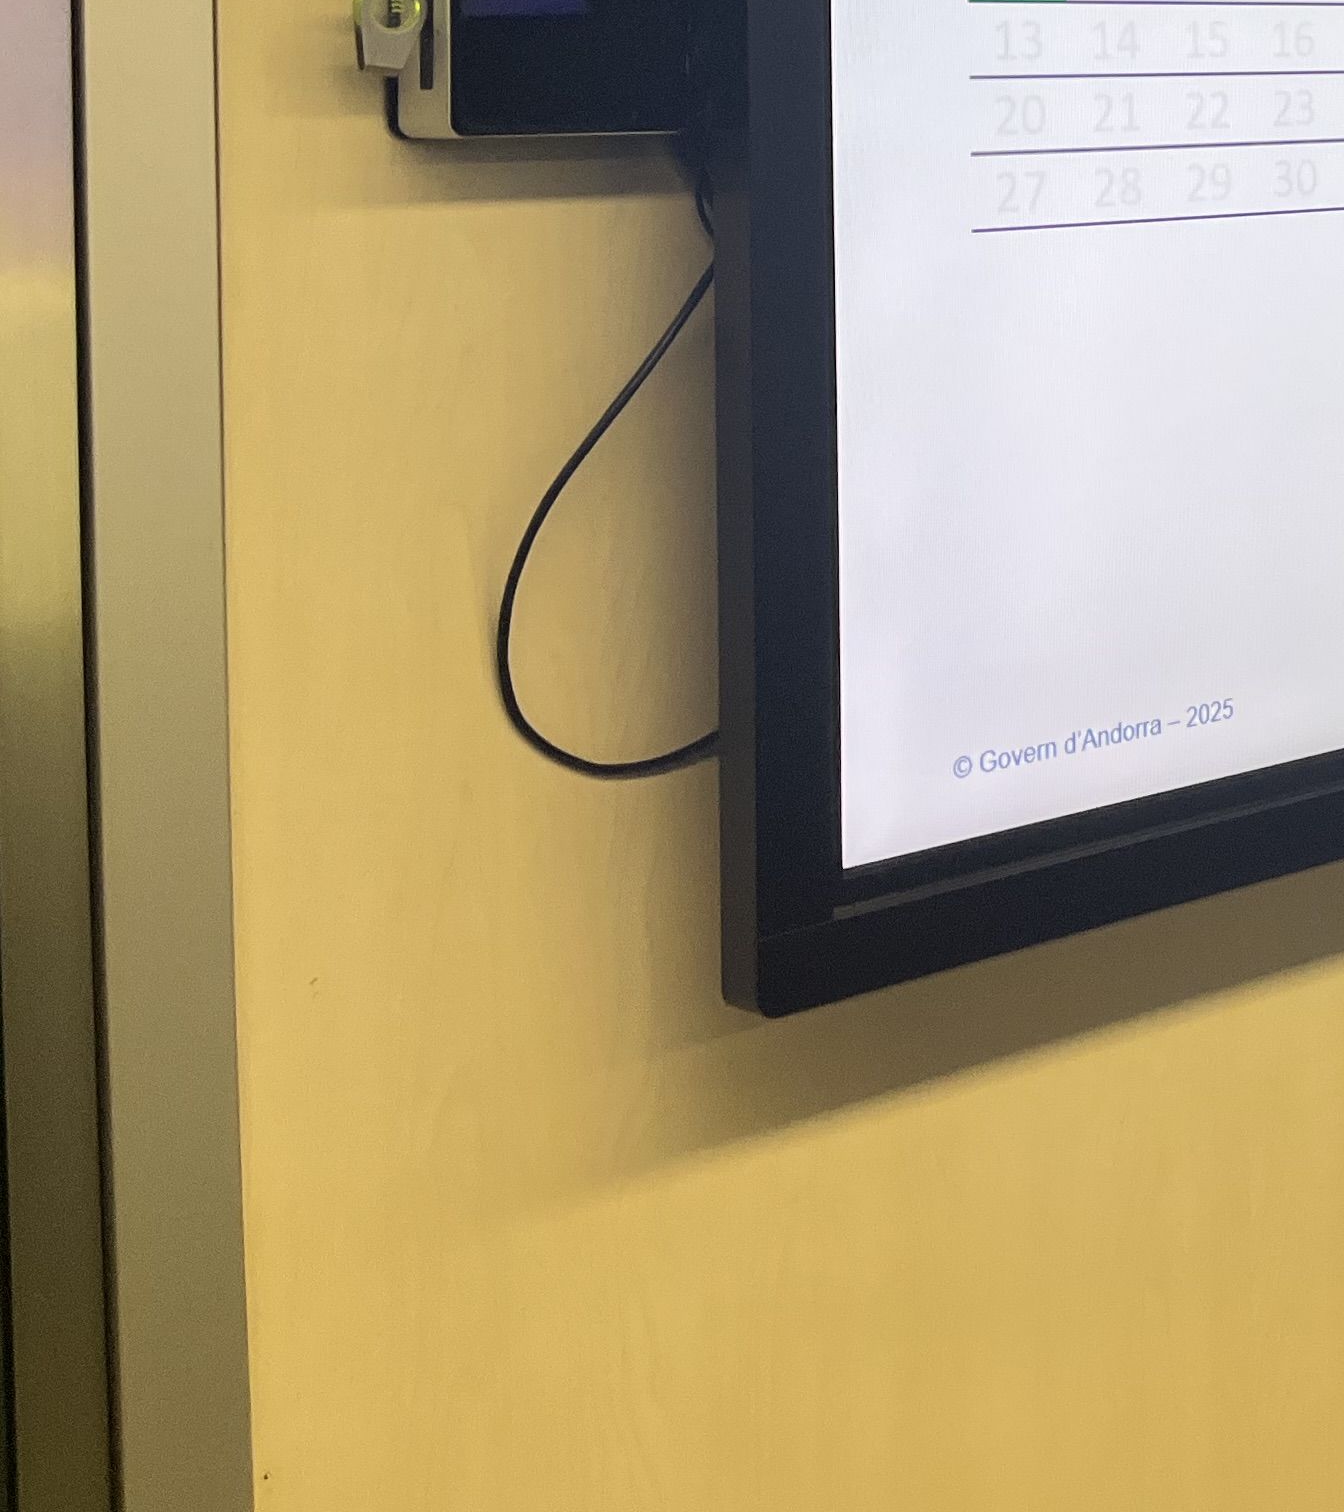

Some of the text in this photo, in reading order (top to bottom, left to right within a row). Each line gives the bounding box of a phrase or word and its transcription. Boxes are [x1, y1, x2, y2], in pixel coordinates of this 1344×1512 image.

[995, 20, 1043, 61] 13
[1092, 20, 1139, 60] 14
[1186, 20, 1228, 58] 15
[1272, 20, 1315, 56] 16
[996, 94, 1047, 136] 20
[1093, 93, 1141, 132] 21
[1186, 91, 1230, 130] 22
[1272, 90, 1315, 127] 23
[995, 160, 1317, 214] 27 28 29 30
[980, 740, 1056, 772] Govern
[1187, 698, 1234, 728] 2025
